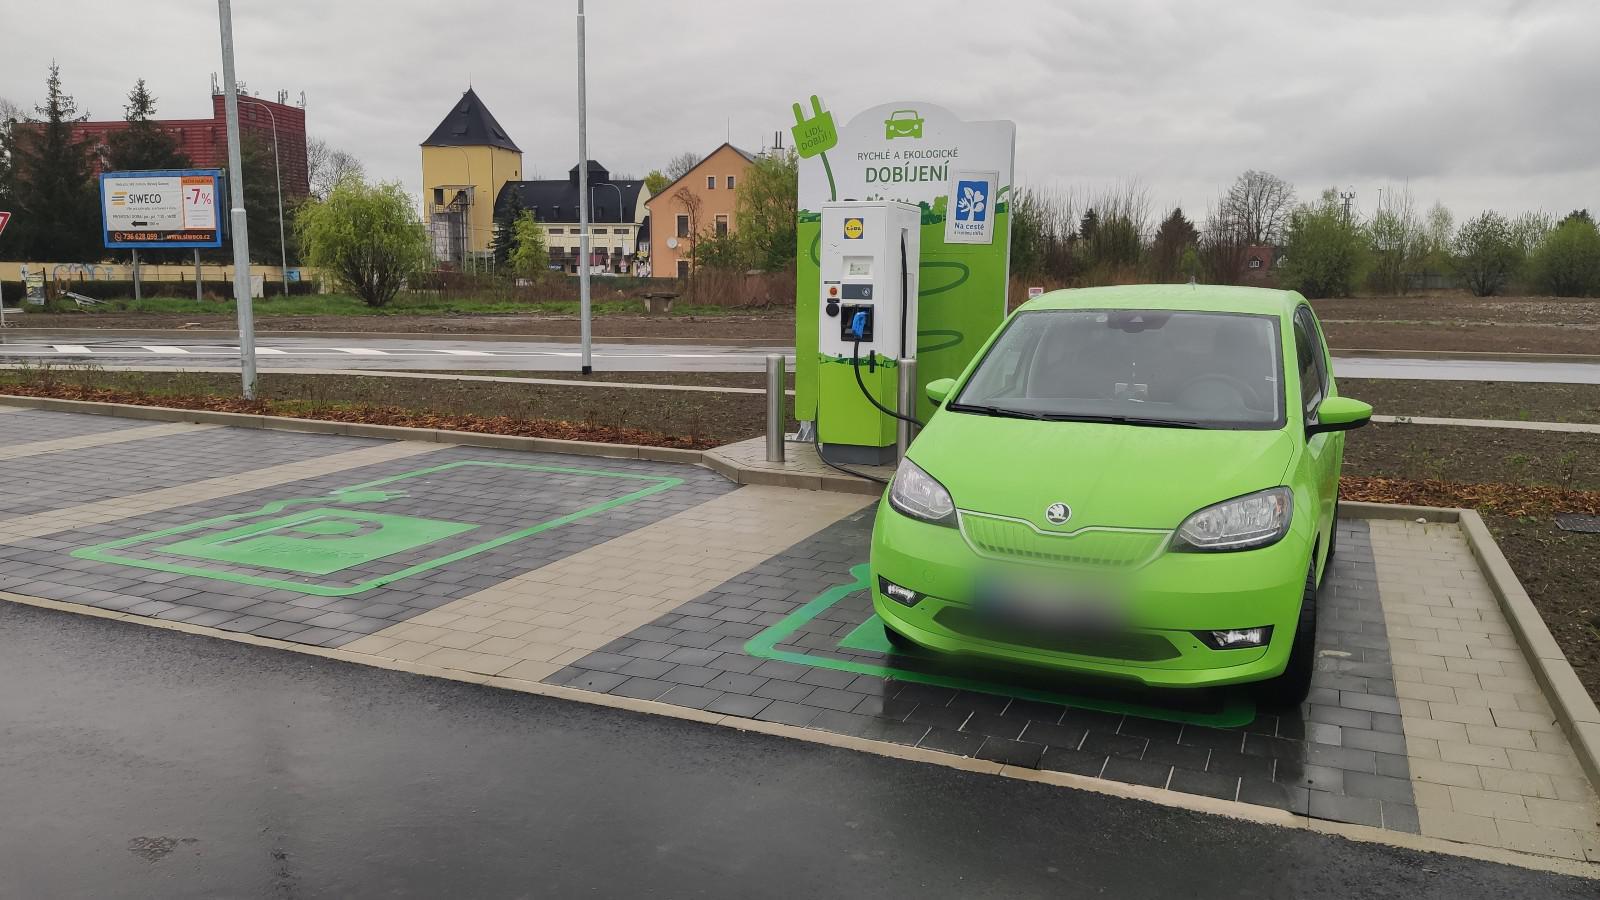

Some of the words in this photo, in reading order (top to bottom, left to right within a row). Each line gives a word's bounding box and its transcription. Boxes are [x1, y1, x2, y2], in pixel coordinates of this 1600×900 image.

[804, 125, 824, 138] LIDL
[857, 148, 890, 160] RYCHLÉ
[894, 152, 900, 160] A
[903, 147, 959, 159] EKOLOGICKÉ
[866, 160, 949, 183] DOBÍJENÍ
[129, 194, 161, 204] SIWECO
